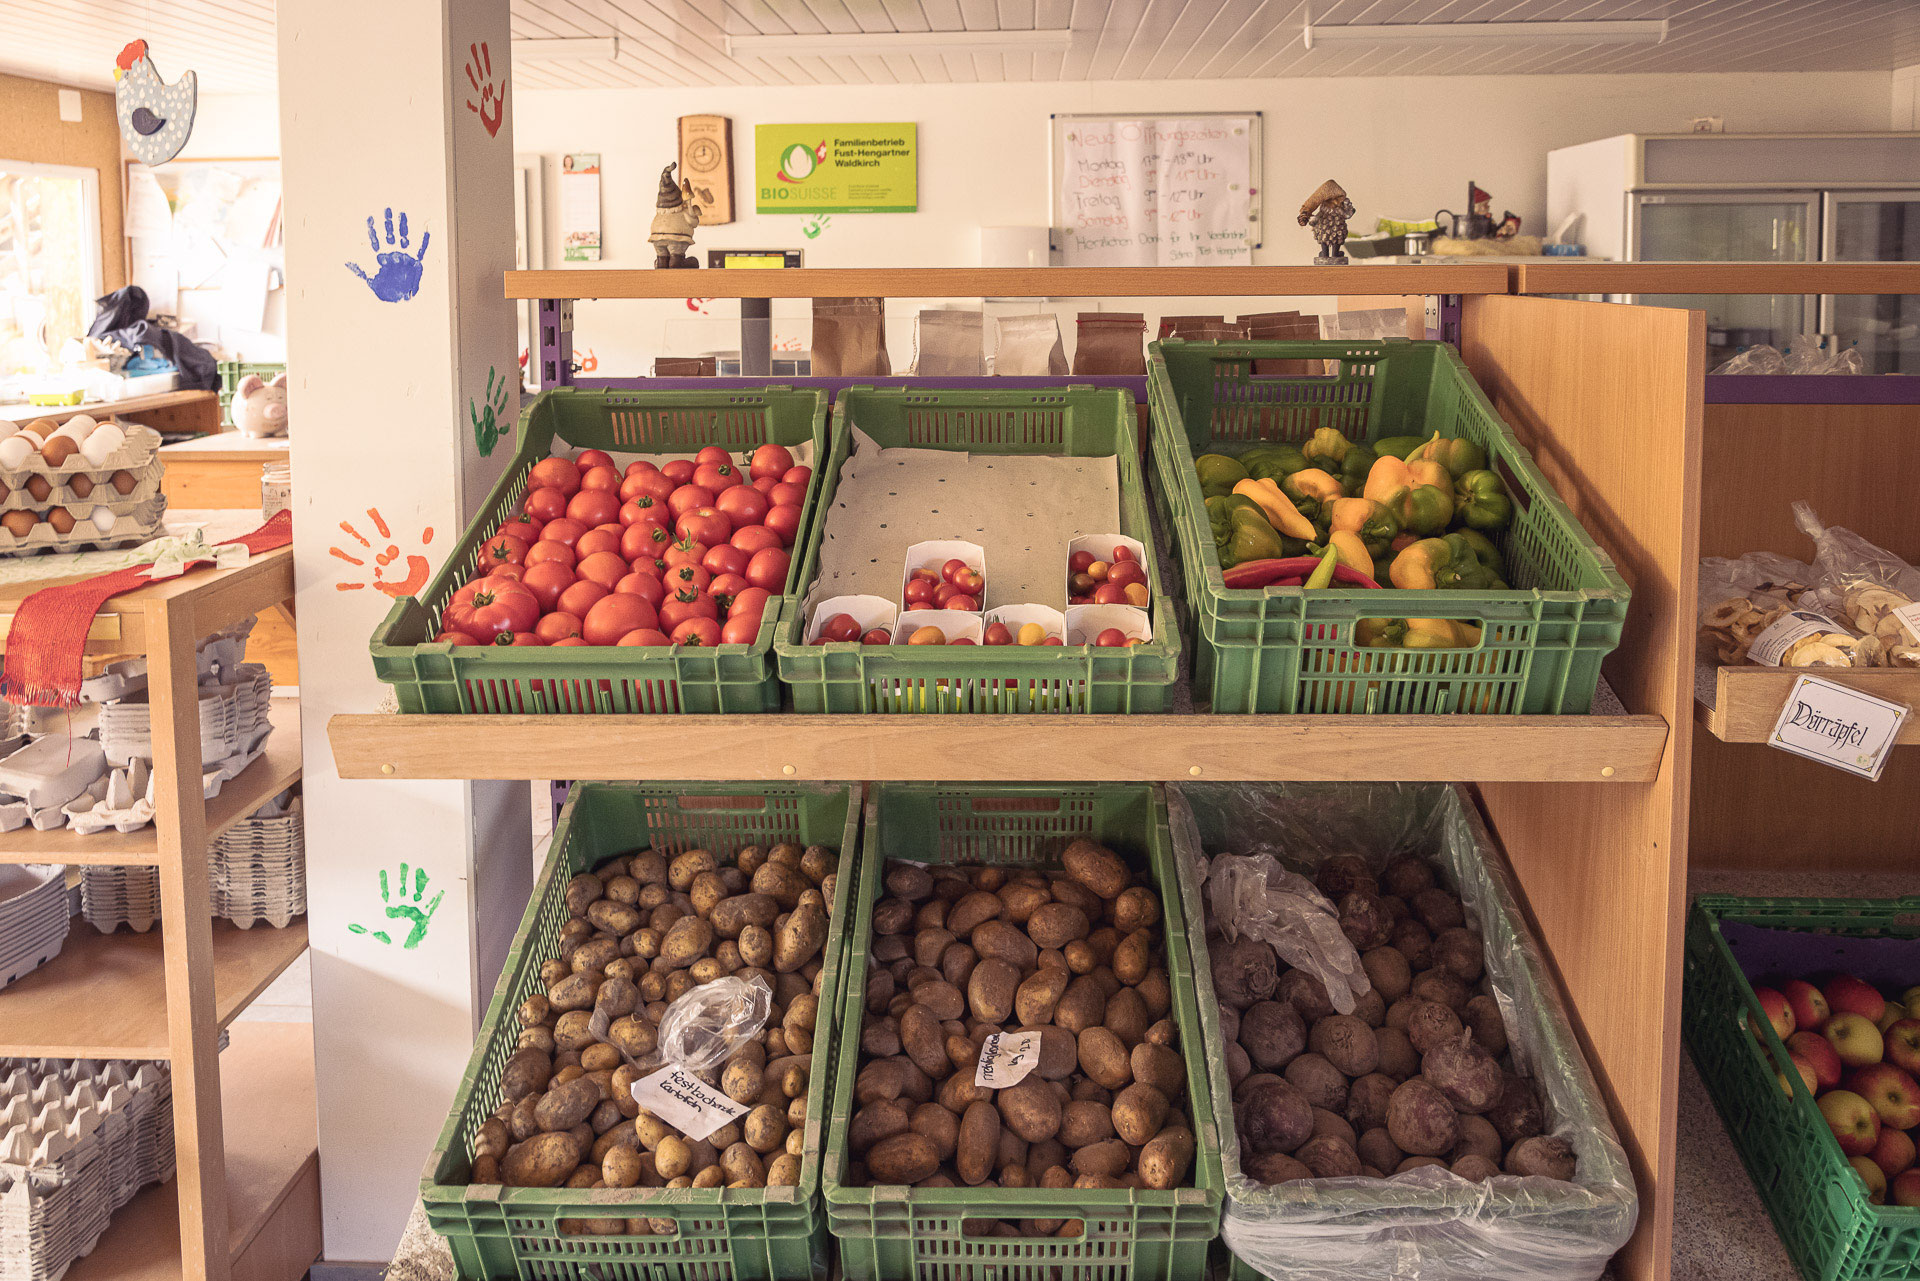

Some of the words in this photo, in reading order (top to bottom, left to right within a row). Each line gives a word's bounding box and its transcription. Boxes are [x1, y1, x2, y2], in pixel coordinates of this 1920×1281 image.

[834, 138, 905, 147] Familienbetrieb
[834, 149, 910, 158] Fust-Hengartner
[835, 159, 880, 167] Waldkirch
[1078, 159, 1126, 174] Montag
[1076, 235, 1133, 253] Herzlichen
[1788, 700, 1869, 750] Dörräpfel
